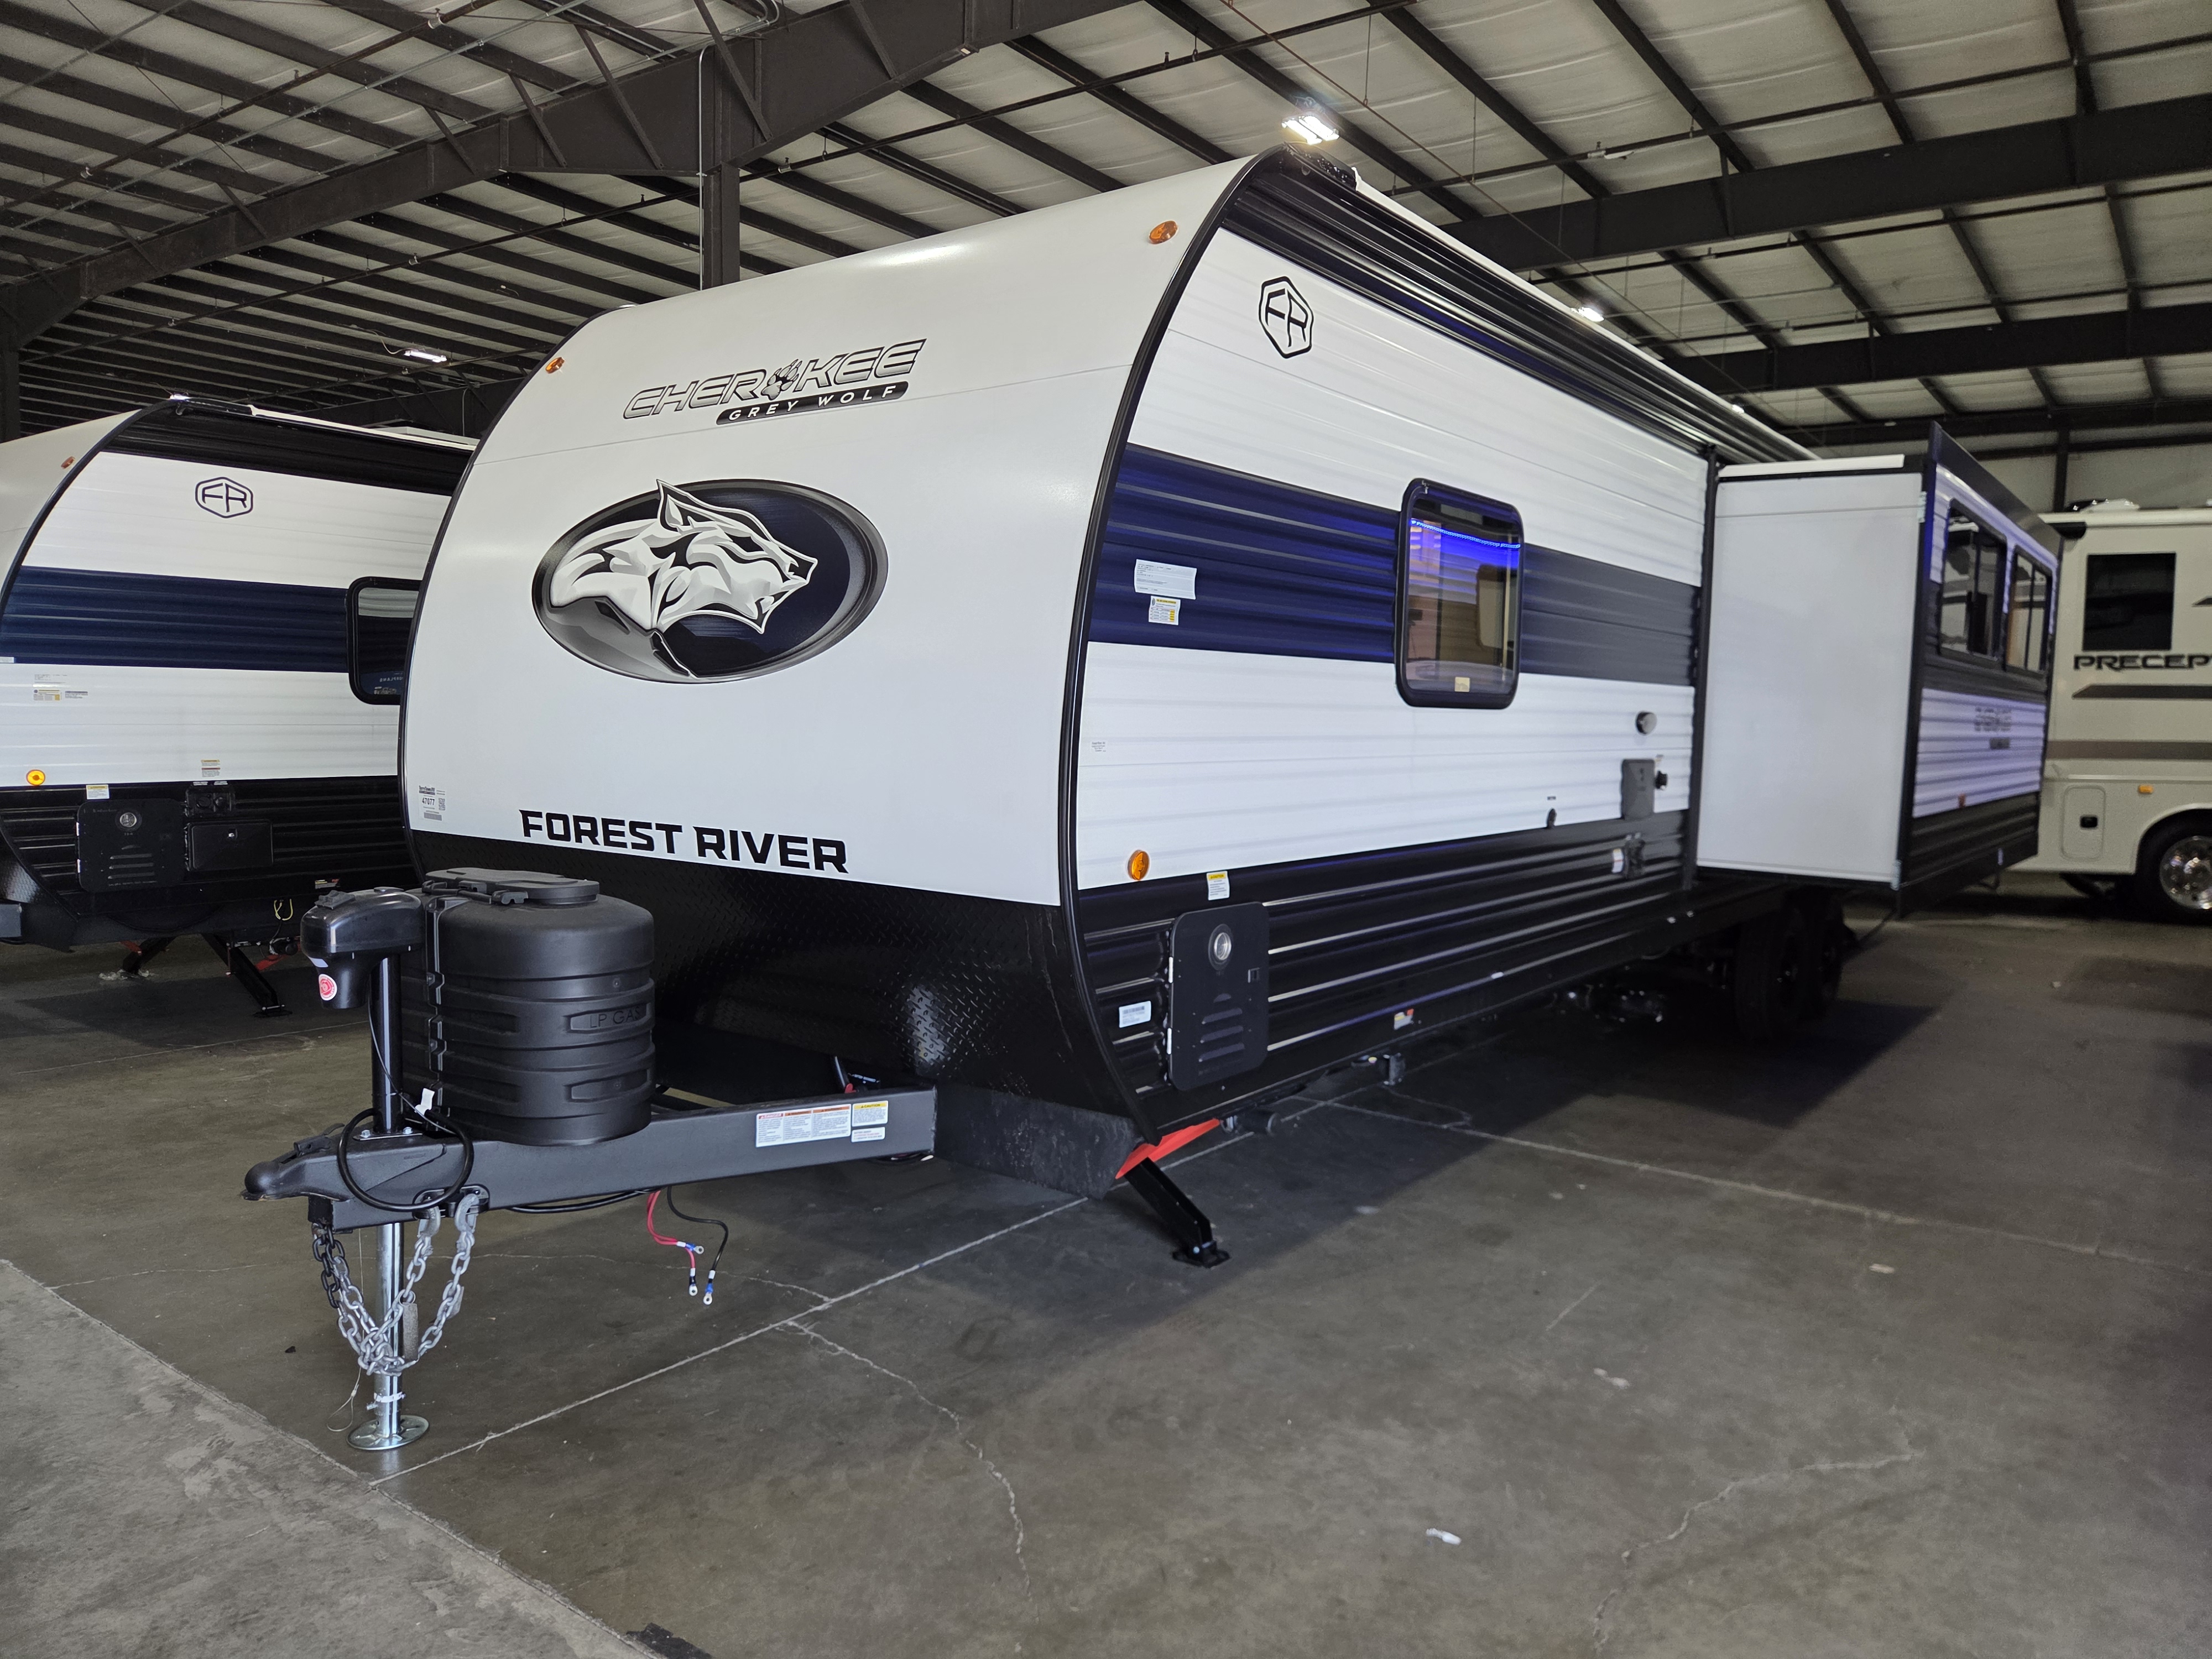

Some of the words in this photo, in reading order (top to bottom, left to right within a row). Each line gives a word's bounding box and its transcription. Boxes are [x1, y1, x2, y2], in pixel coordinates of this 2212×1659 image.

[623, 338, 927, 419] CHEROKEE
[729, 401, 800, 421] GREY
[818, 385, 896, 407] WOLF
[2074, 655, 2212, 673] PRECEP
[422, 797, 435, 806] 47077
[519, 810, 682, 854] FOREST
[692, 826, 848, 873] RIVER
[589, 1014, 607, 1028] LP
[613, 1006, 640, 1024] GAS
